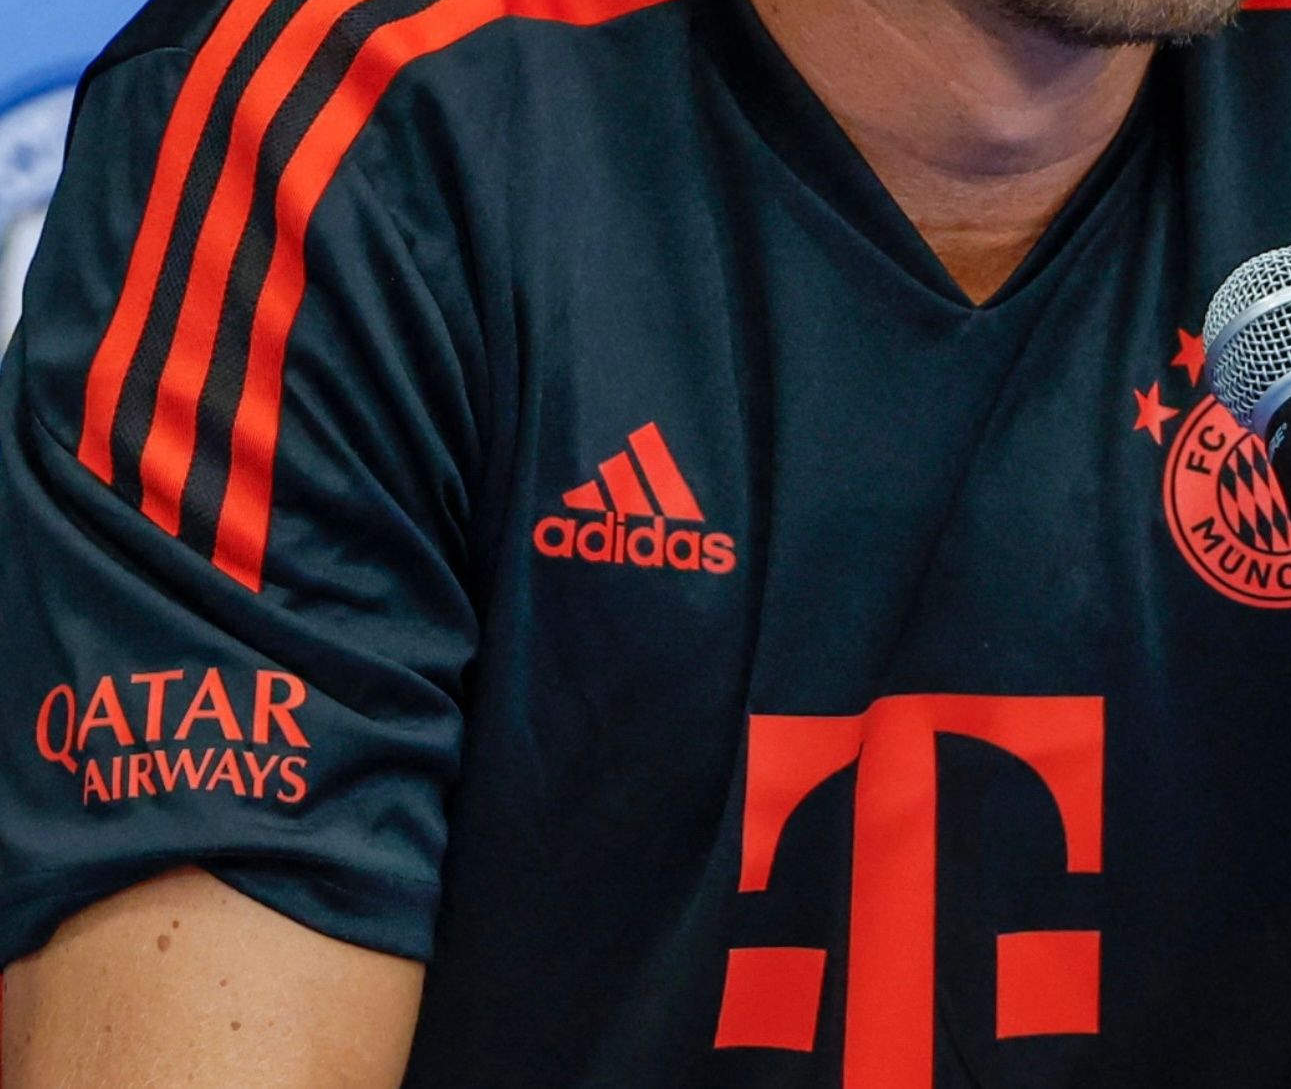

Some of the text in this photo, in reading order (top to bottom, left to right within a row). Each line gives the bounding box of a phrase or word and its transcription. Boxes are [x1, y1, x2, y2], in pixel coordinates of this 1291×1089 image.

[1186, 425, 1226, 475] FC
[533, 511, 736, 574] adidas
[36, 667, 310, 772] QATAR
[83, 747, 309, 805] AIRWAYS
